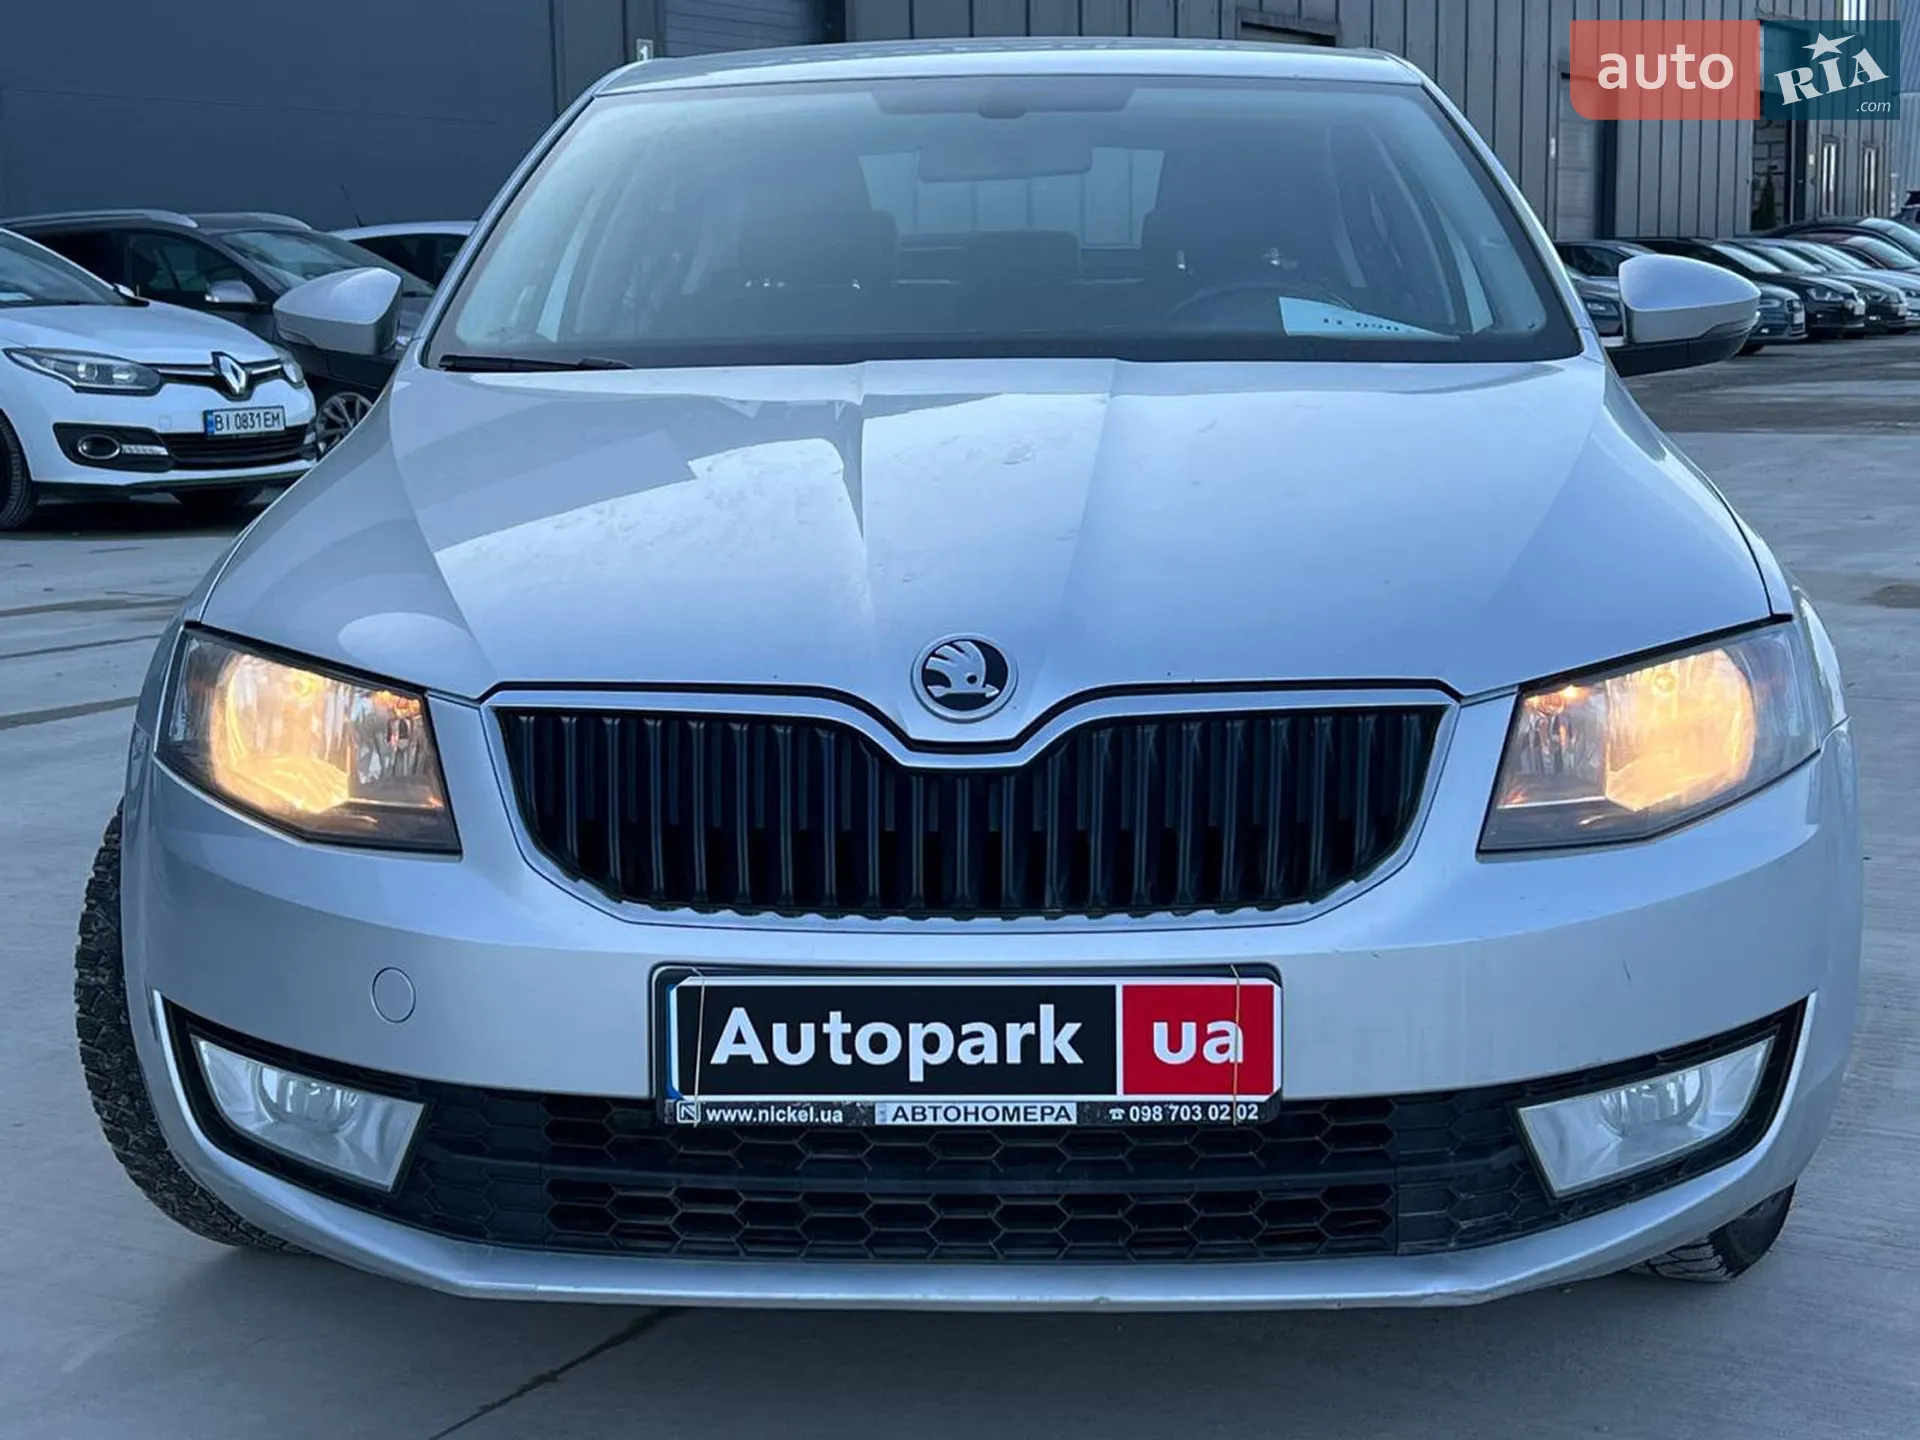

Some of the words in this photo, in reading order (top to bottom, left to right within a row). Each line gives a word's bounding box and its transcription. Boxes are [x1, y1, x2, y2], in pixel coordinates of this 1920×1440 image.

[709, 1003, 1084, 1083] Autopark
[1152, 1019, 1245, 1065] ua
[706, 1105, 844, 1123] www.nickel.ua
[891, 1105, 1073, 1122] АВТОНОМЕРА
[1129, 1105, 1164, 1122] 098
[1168, 1105, 1202, 1122] 703
[1235, 1104, 1259, 1121] 02
